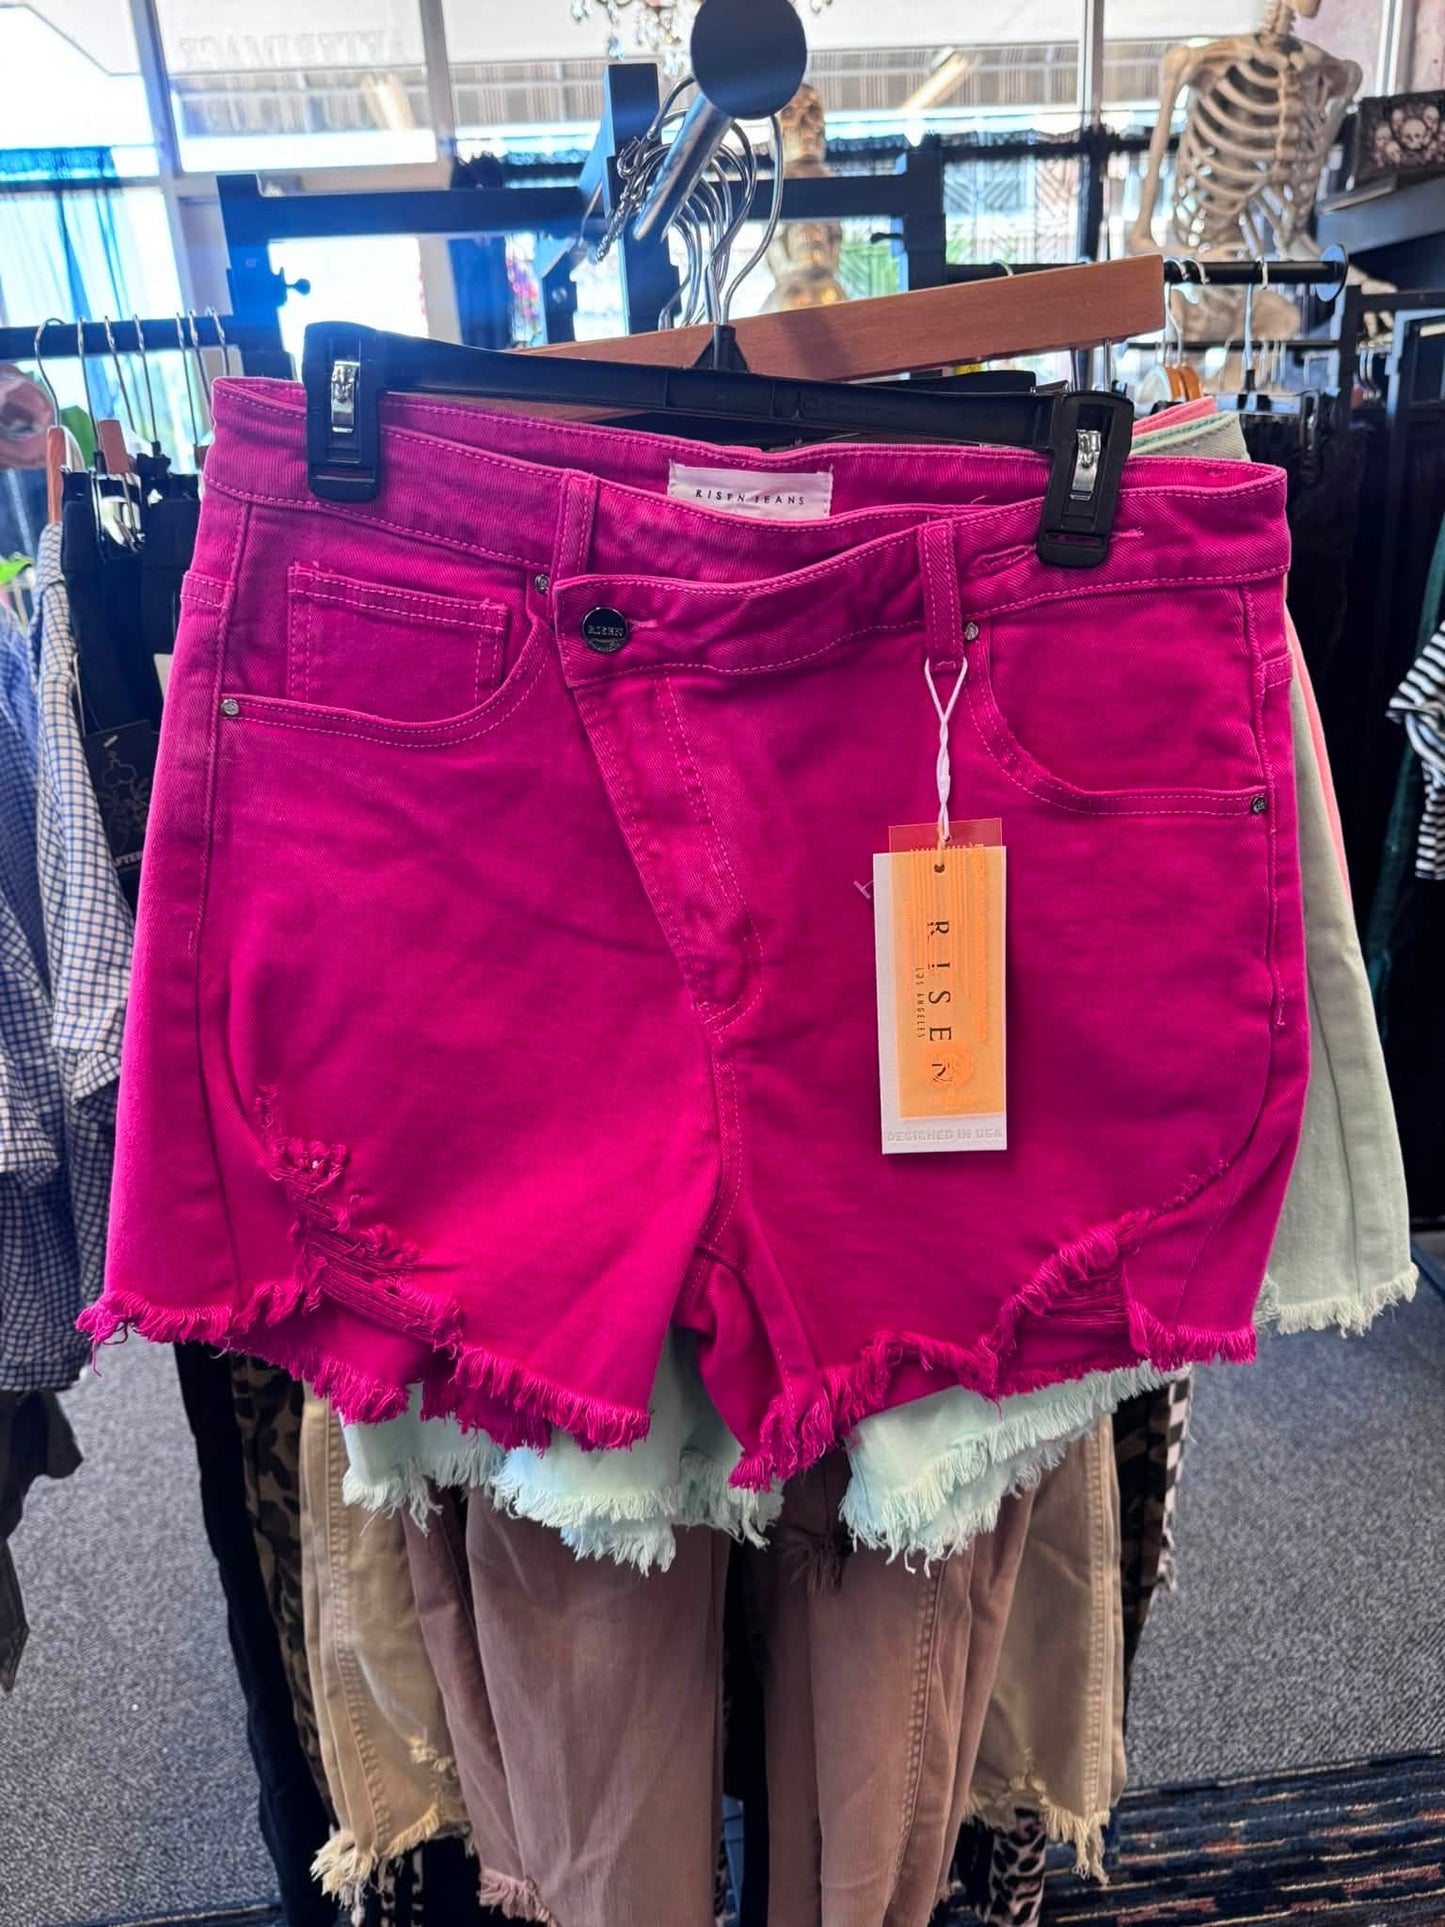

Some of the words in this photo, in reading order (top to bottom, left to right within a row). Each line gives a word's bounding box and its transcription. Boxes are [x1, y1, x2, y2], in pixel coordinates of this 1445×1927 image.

[754, 495, 805, 506] JEANS
[887, 1129, 953, 1142] DESIGNED
[957, 1128, 972, 1140] IN
[974, 1127, 1003, 1139] USA
